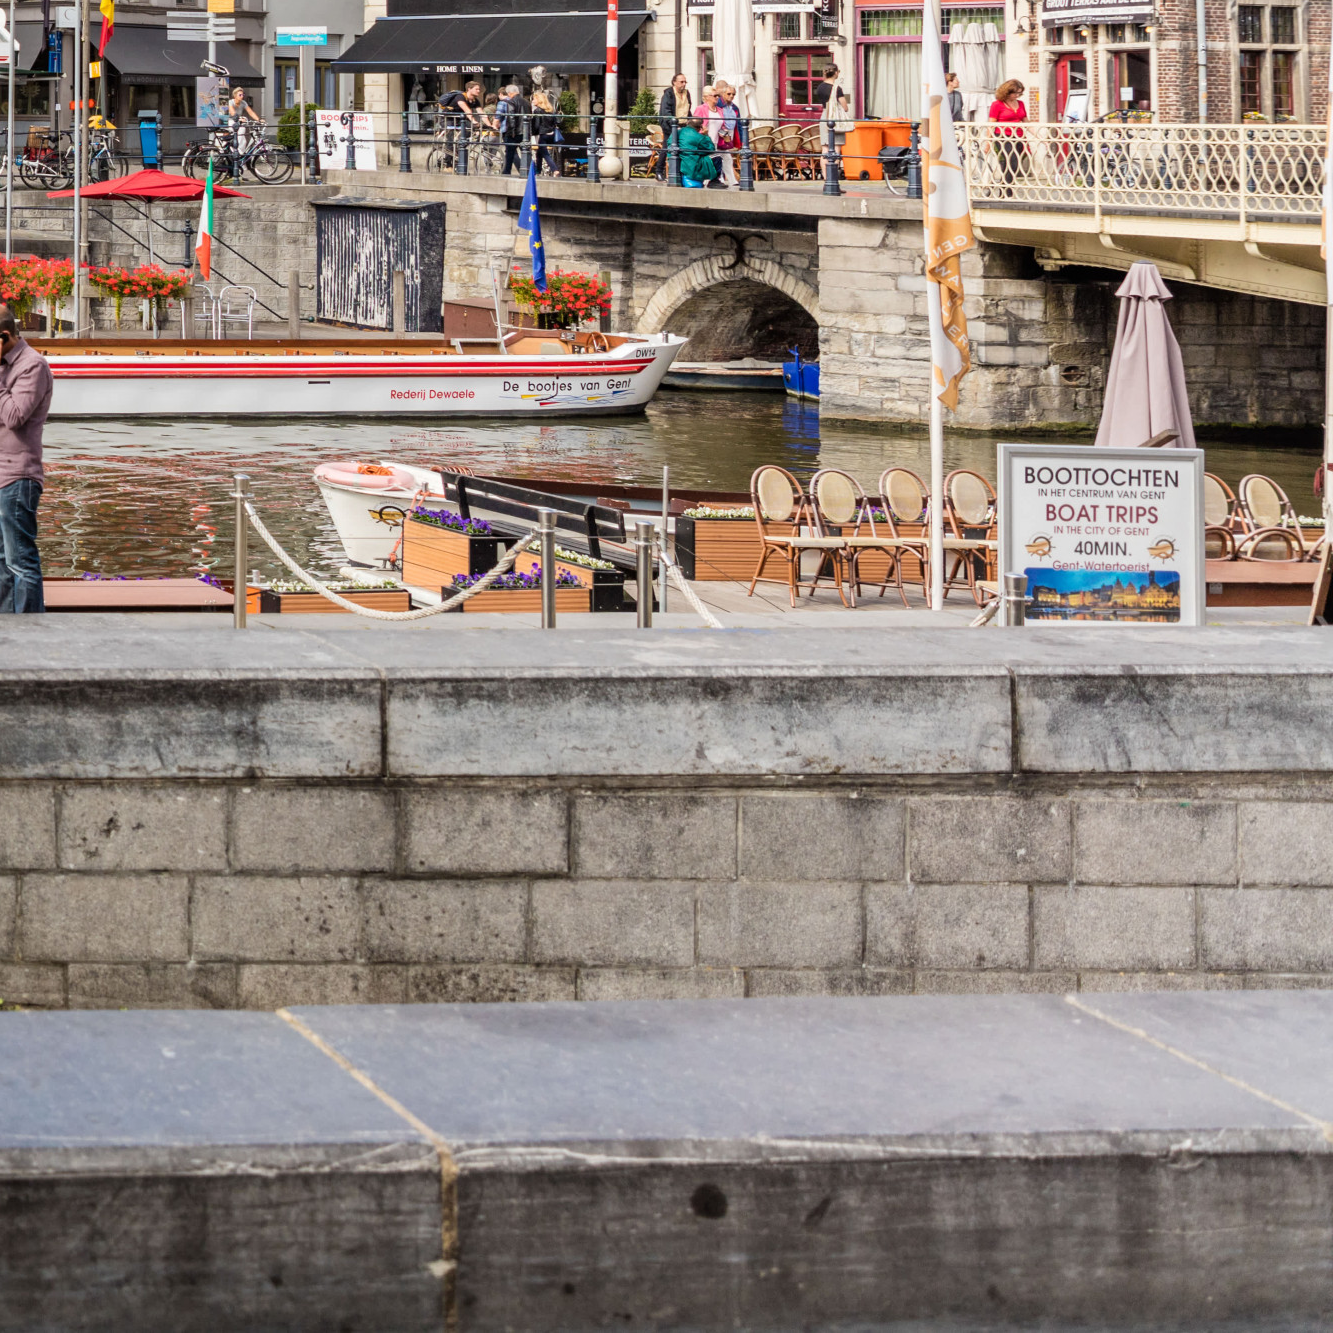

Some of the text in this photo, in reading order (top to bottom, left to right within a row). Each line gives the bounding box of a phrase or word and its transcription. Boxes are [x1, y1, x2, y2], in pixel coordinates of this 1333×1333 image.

[436, 65, 457, 73] HOME
[461, 65, 484, 73] LINEN
[635, 348, 656, 358] DW14
[503, 376, 632, 401] De bootjes van Gent
[390, 389, 475, 401] Rederij Dewaele
[1024, 466, 1179, 488] BOOTTOCHTEN
[1038, 488, 1166, 500] IN HET CENTRUM VAN GENT
[1046, 504, 1159, 524] BOAT TRIPS
[1053, 526, 1150, 536] IN THE CITY OF GENT
[1073, 541, 1132, 557] 40MIN.
[1052, 560, 1150, 572] Gent-Watertoerist
